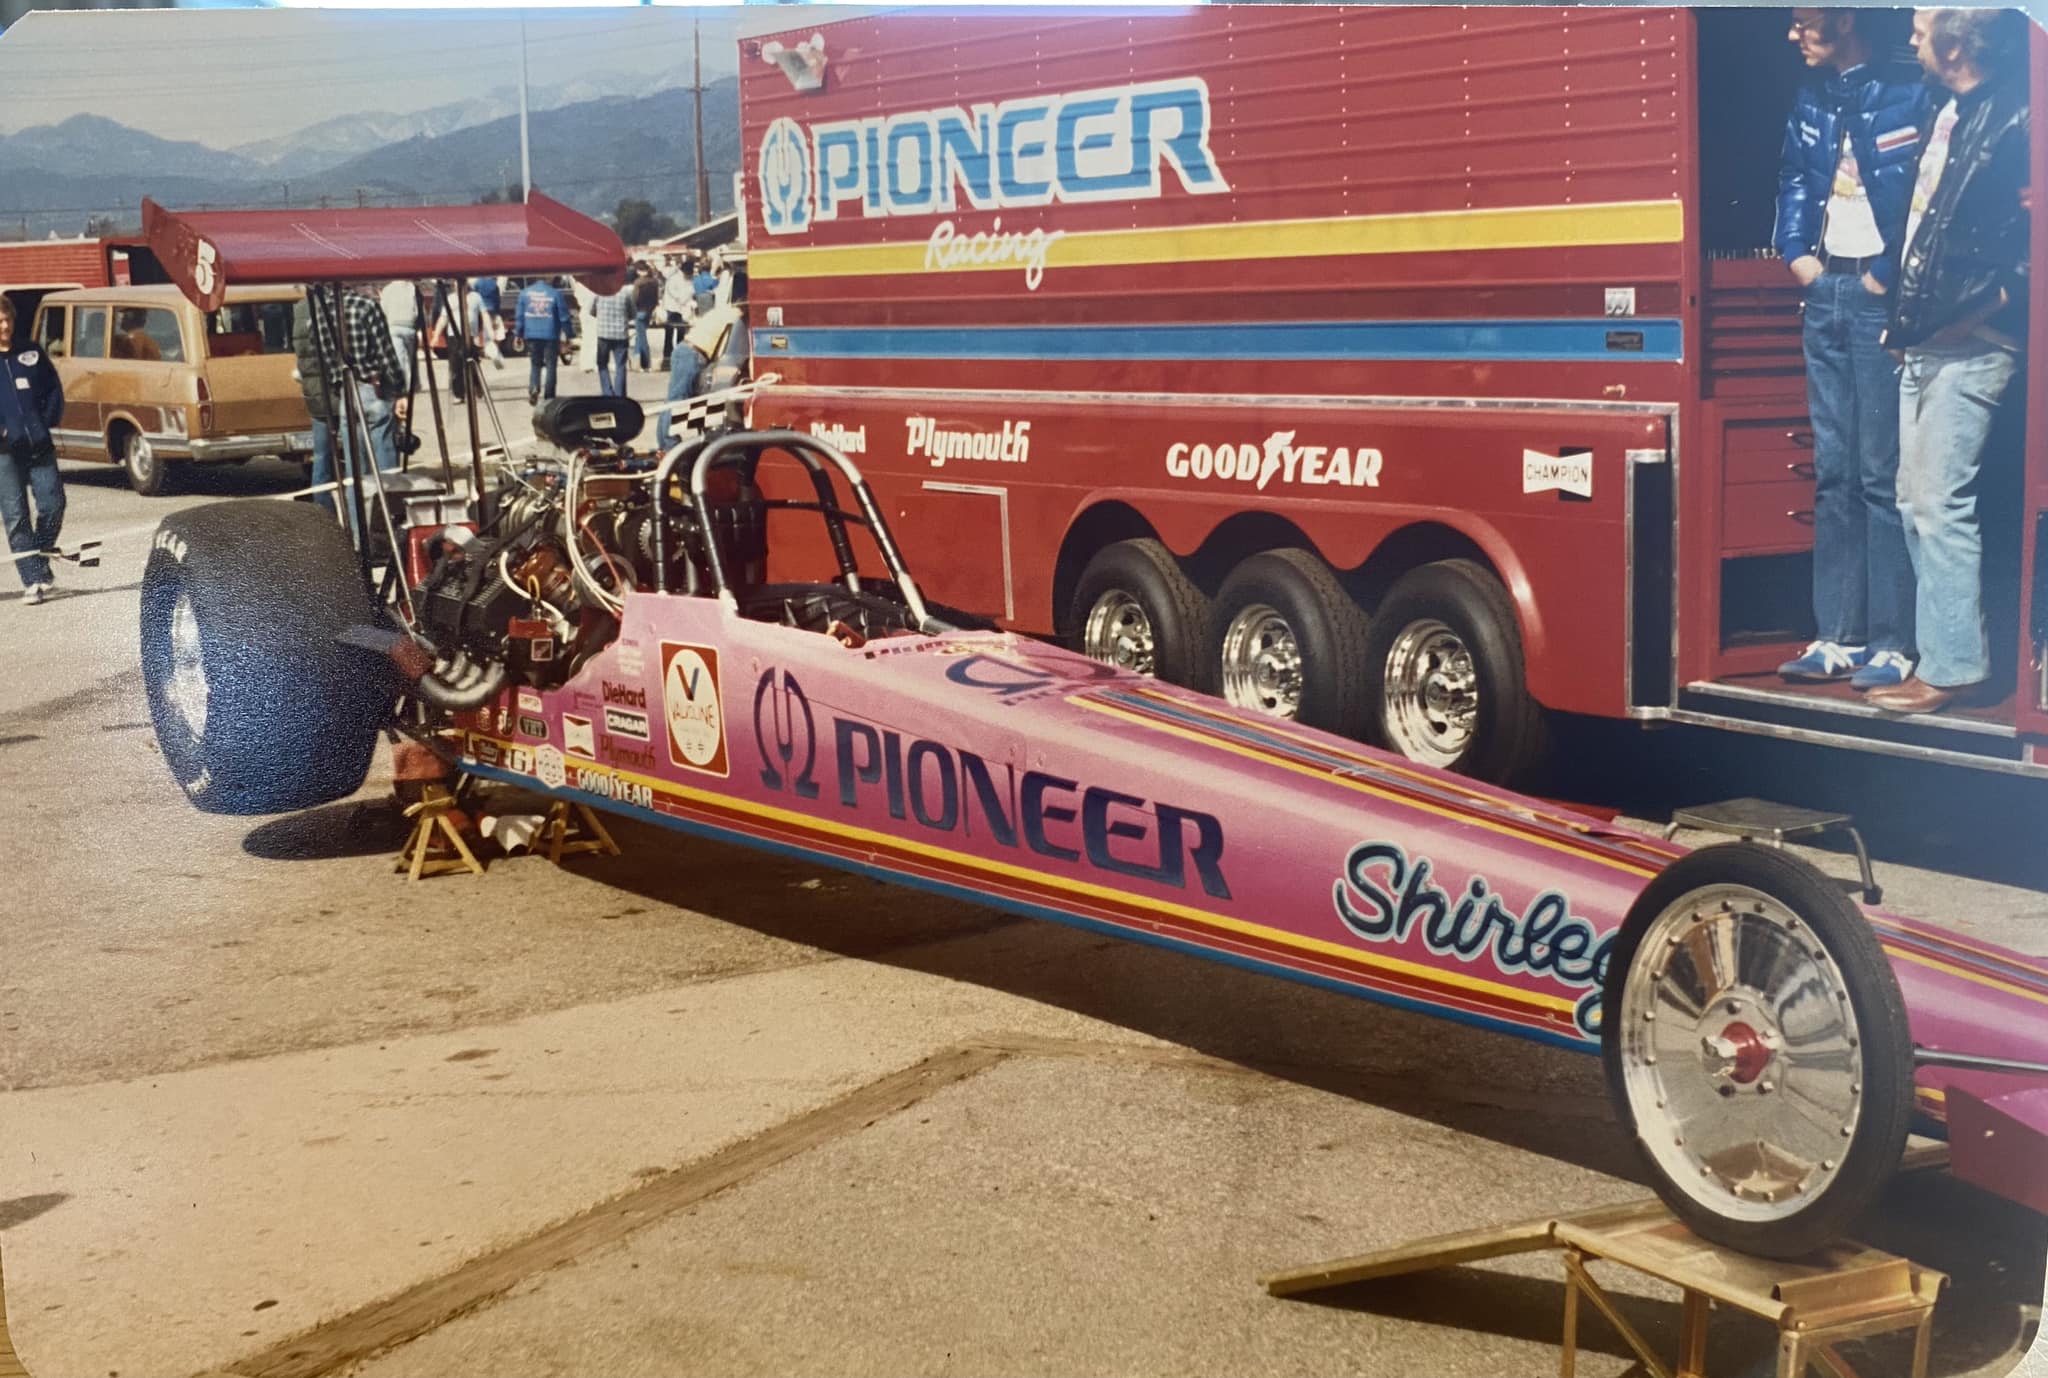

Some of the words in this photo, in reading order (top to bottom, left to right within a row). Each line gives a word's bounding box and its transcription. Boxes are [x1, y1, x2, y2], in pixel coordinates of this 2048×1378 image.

[811, 77, 1231, 220] PIONEER
[924, 216, 1064, 291] Racing
[905, 416, 1031, 467] Plymouth
[1166, 431, 1383, 490] GOODYEAR
[1526, 463, 1588, 483] CHAMPION
[602, 679, 647, 710] DieHard
[607, 711, 648, 735] CRAGAR
[599, 734, 656, 772] Plymouth
[576, 767, 655, 810] GOODYEAR
[834, 717, 1233, 900] PIONEER
